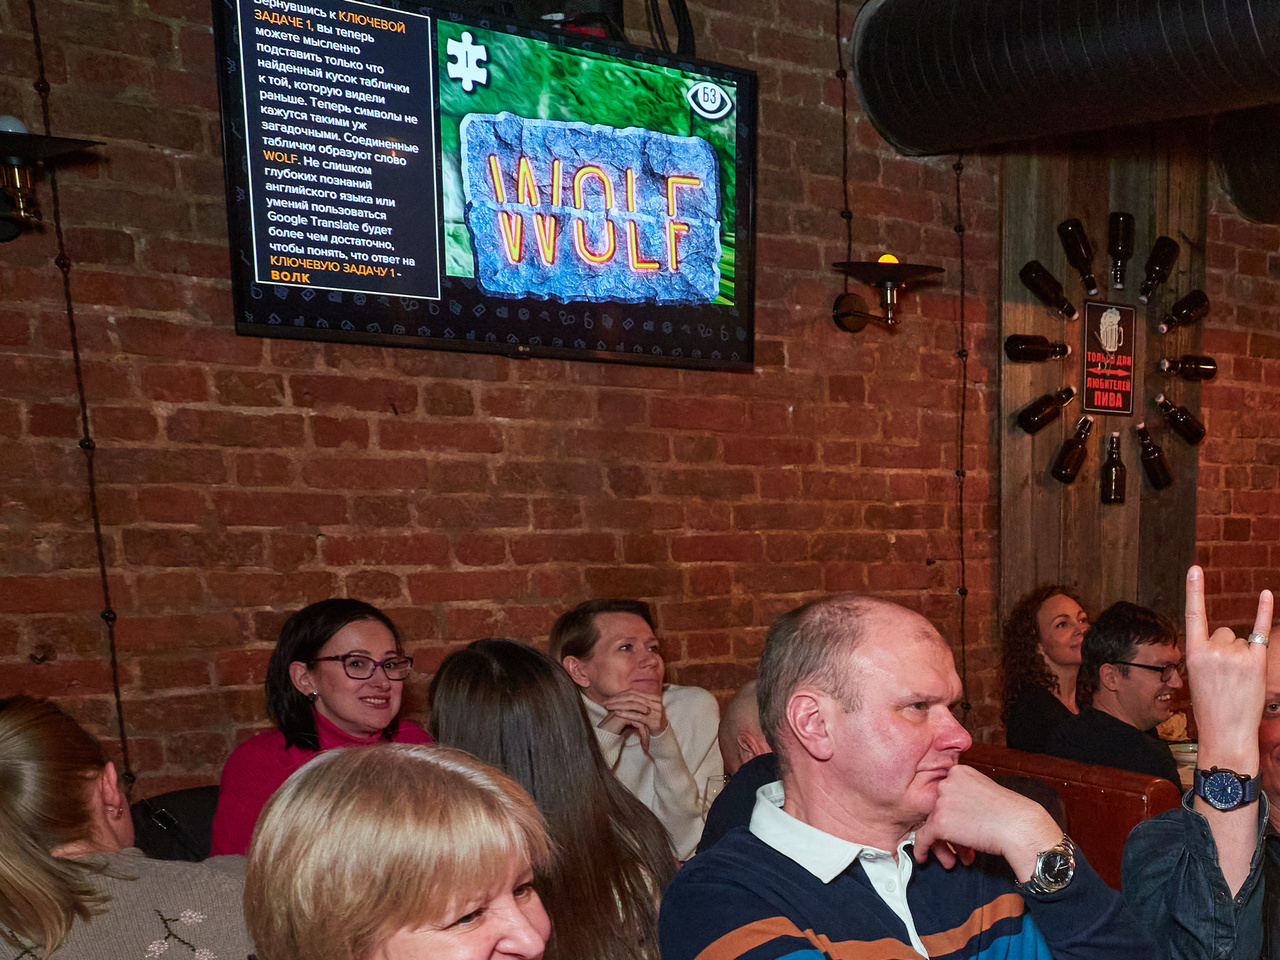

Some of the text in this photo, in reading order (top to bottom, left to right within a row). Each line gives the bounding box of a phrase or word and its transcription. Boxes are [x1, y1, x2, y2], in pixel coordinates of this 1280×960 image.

[254, 9, 375, 43] ЗАДАЧЕ 1, вы теперь
[329, 10, 337, 20] к
[338, 10, 406, 34] КЛЮЧЕВОЙ
[255, 26, 361, 55] можете мысленно
[256, 42, 385, 75] подставить только что
[257, 58, 410, 94] найденный кусок таблички
[258, 74, 386, 105] к той, которую видели
[259, 90, 419, 125] раньше. Теперь символы не
[260, 105, 368, 131] кажутся такими уж
[261, 121, 419, 154] загадочными. Соединенные
[261, 136, 407, 166] таблички образуют слово
[262, 149, 373, 175] WOLF. Не слишком
[264, 167, 373, 190] глубоких познаний
[265, 182, 396, 207] английского языка или
[265, 197, 387, 220] умений пользоваться
[267, 210, 393, 236] Google Translate будет
[268, 226, 395, 251] более чем достаточно,
[269, 242, 416, 267] чтобы понять, что ответ на
[270, 255, 340, 272] КЛЮЧЕВУЮ
[342, 263, 388, 277] ЗАДАЧУ
[390, 268, 395, 277] 1
[271, 270, 310, 283] ВОЛК
[1087, 351, 1131, 366] ТОЛЬО ДЛЯ
[1086, 377, 1131, 392] ЛЮБИТЕЛЕЙ
[1094, 390, 1123, 408] ПИВА
